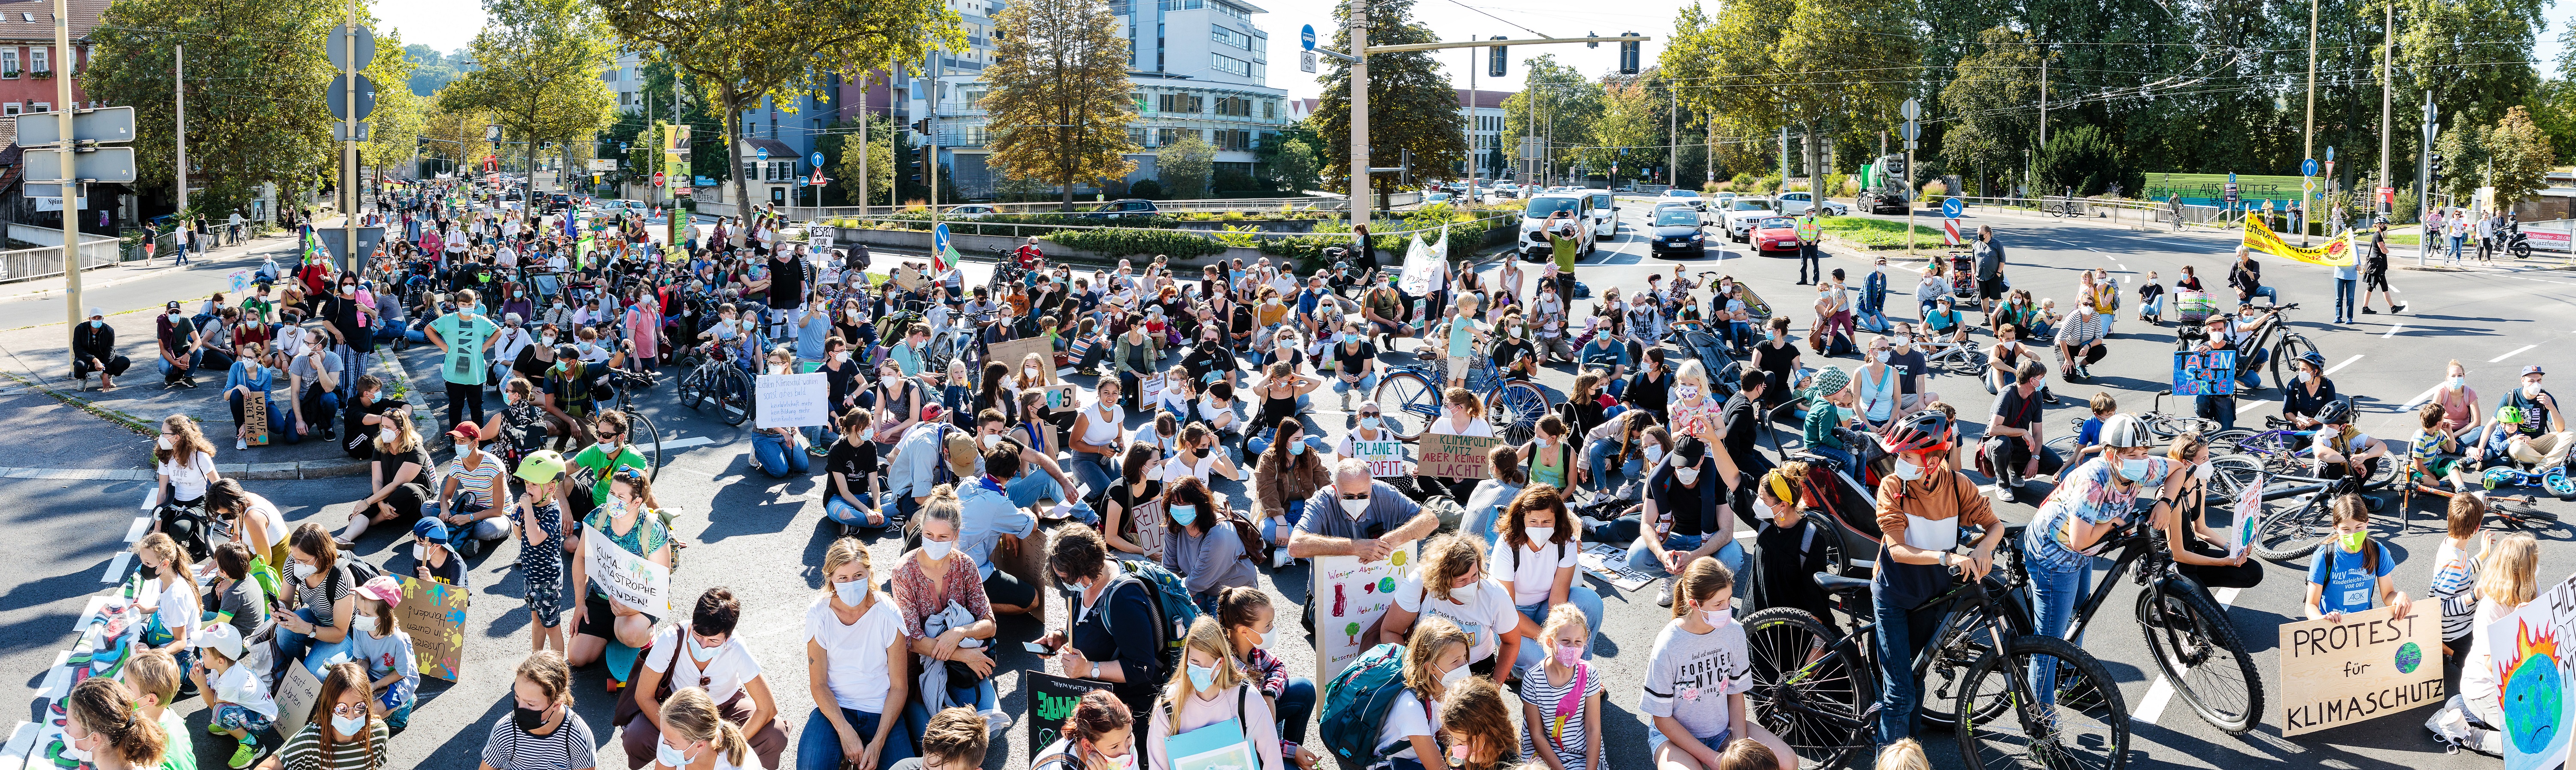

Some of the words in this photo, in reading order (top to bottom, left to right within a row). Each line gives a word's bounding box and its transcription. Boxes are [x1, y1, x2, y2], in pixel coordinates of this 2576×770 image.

[811, 227, 835, 237] RESPECT
[758, 377, 774, 388] Echten
[803, 375, 818, 385] wählen
[764, 388, 777, 400] sonst
[795, 387, 806, 397] bald
[255, 396, 266, 433] WORAUF
[781, 407, 796, 415] Bildung
[1422, 434, 1437, 443] Eure
[1440, 434, 1502, 448] KLIMAPOLITIK
[1356, 442, 1400, 455] PLANET
[1443, 445, 1471, 455] WITZ
[1422, 453, 1449, 462] ABER
[1455, 454, 1486, 464] KEINER
[173, 469, 187, 477] SAVE
[1437, 464, 1481, 477] LACHT
[2243, 479, 2261, 504] WENIGER
[2242, 494, 2259, 520] AUTOS
[597, 543, 621, 571] KLIMA-
[597, 555, 656, 596] KATASTROPHE
[1328, 570, 1355, 579] Weniger
[2332, 571, 2347, 580] WLV
[598, 570, 648, 606] ABWENDEN!
[2348, 591, 2364, 601] AOK
[1357, 605, 1371, 615] Mehr
[1373, 603, 1391, 612] Natur
[408, 606, 447, 628] Händen!
[407, 623, 431, 634] euren
[1955, 633, 1966, 644] CUBE
[2293, 615, 2418, 658] PROTEST
[415, 638, 445, 660] Unsere
[1707, 647, 1722, 657] magique
[1332, 652, 1356, 662] besseres
[1681, 652, 1730, 676] FOREVER
[2343, 661, 2370, 677] für
[289, 667, 307, 689] Lasst
[304, 686, 314, 700] den
[1696, 668, 1723, 688] NYC
[1792, 673, 1806, 682] CUBE
[1051, 681, 1093, 693] #KLIMAWAHL
[1961, 669, 1982, 725] SCHWALBE
[2288, 678, 2443, 731] KLIMASCHUTZ
